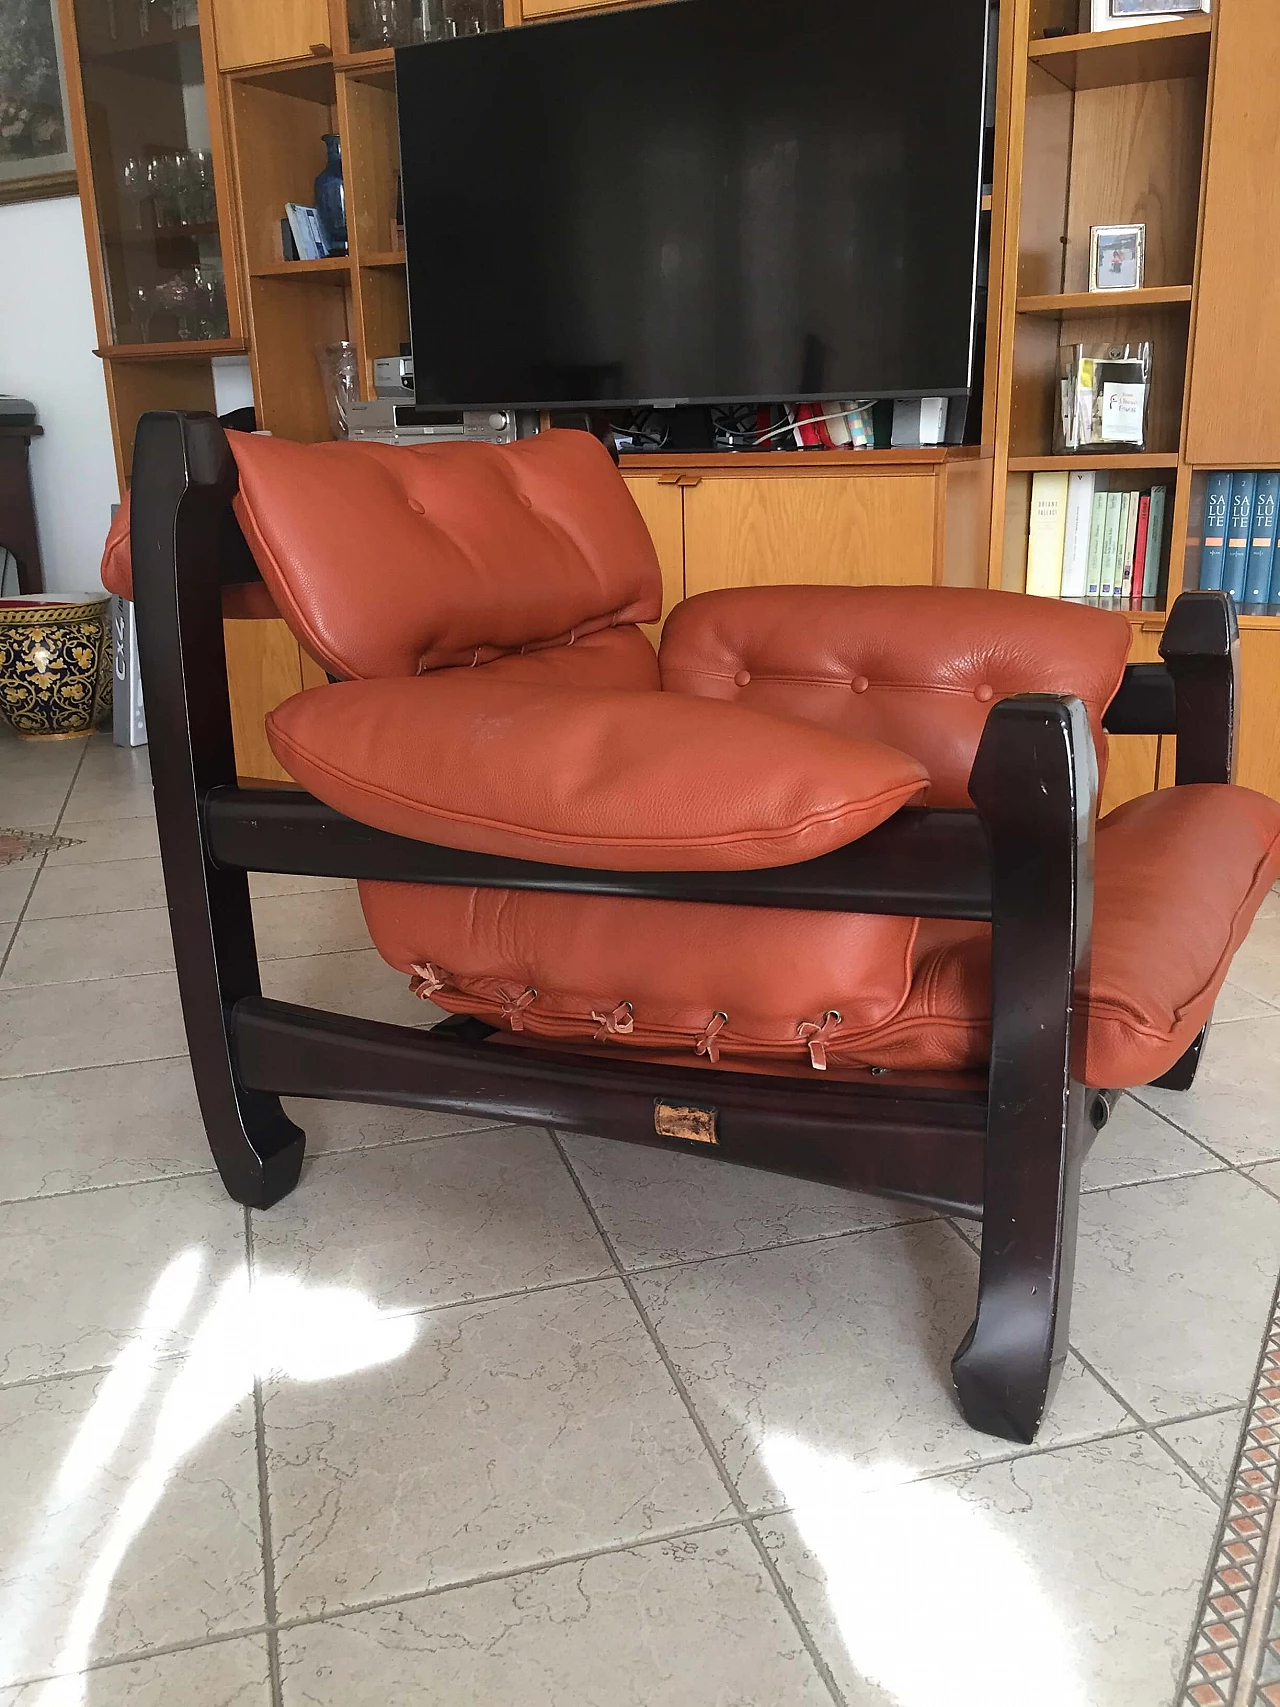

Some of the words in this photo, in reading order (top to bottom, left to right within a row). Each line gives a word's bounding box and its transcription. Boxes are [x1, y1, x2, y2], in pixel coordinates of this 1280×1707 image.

[1209, 495, 1226, 505] SA
[1233, 495, 1250, 506] SA
[1257, 494, 1275, 505] SA
[1209, 506, 1226, 516] LU
[1233, 506, 1250, 517] LU
[1257, 506, 1274, 516] LU
[1208, 516, 1224, 527] TE
[1232, 517, 1248, 528] TE
[1256, 516, 1273, 527] TE
